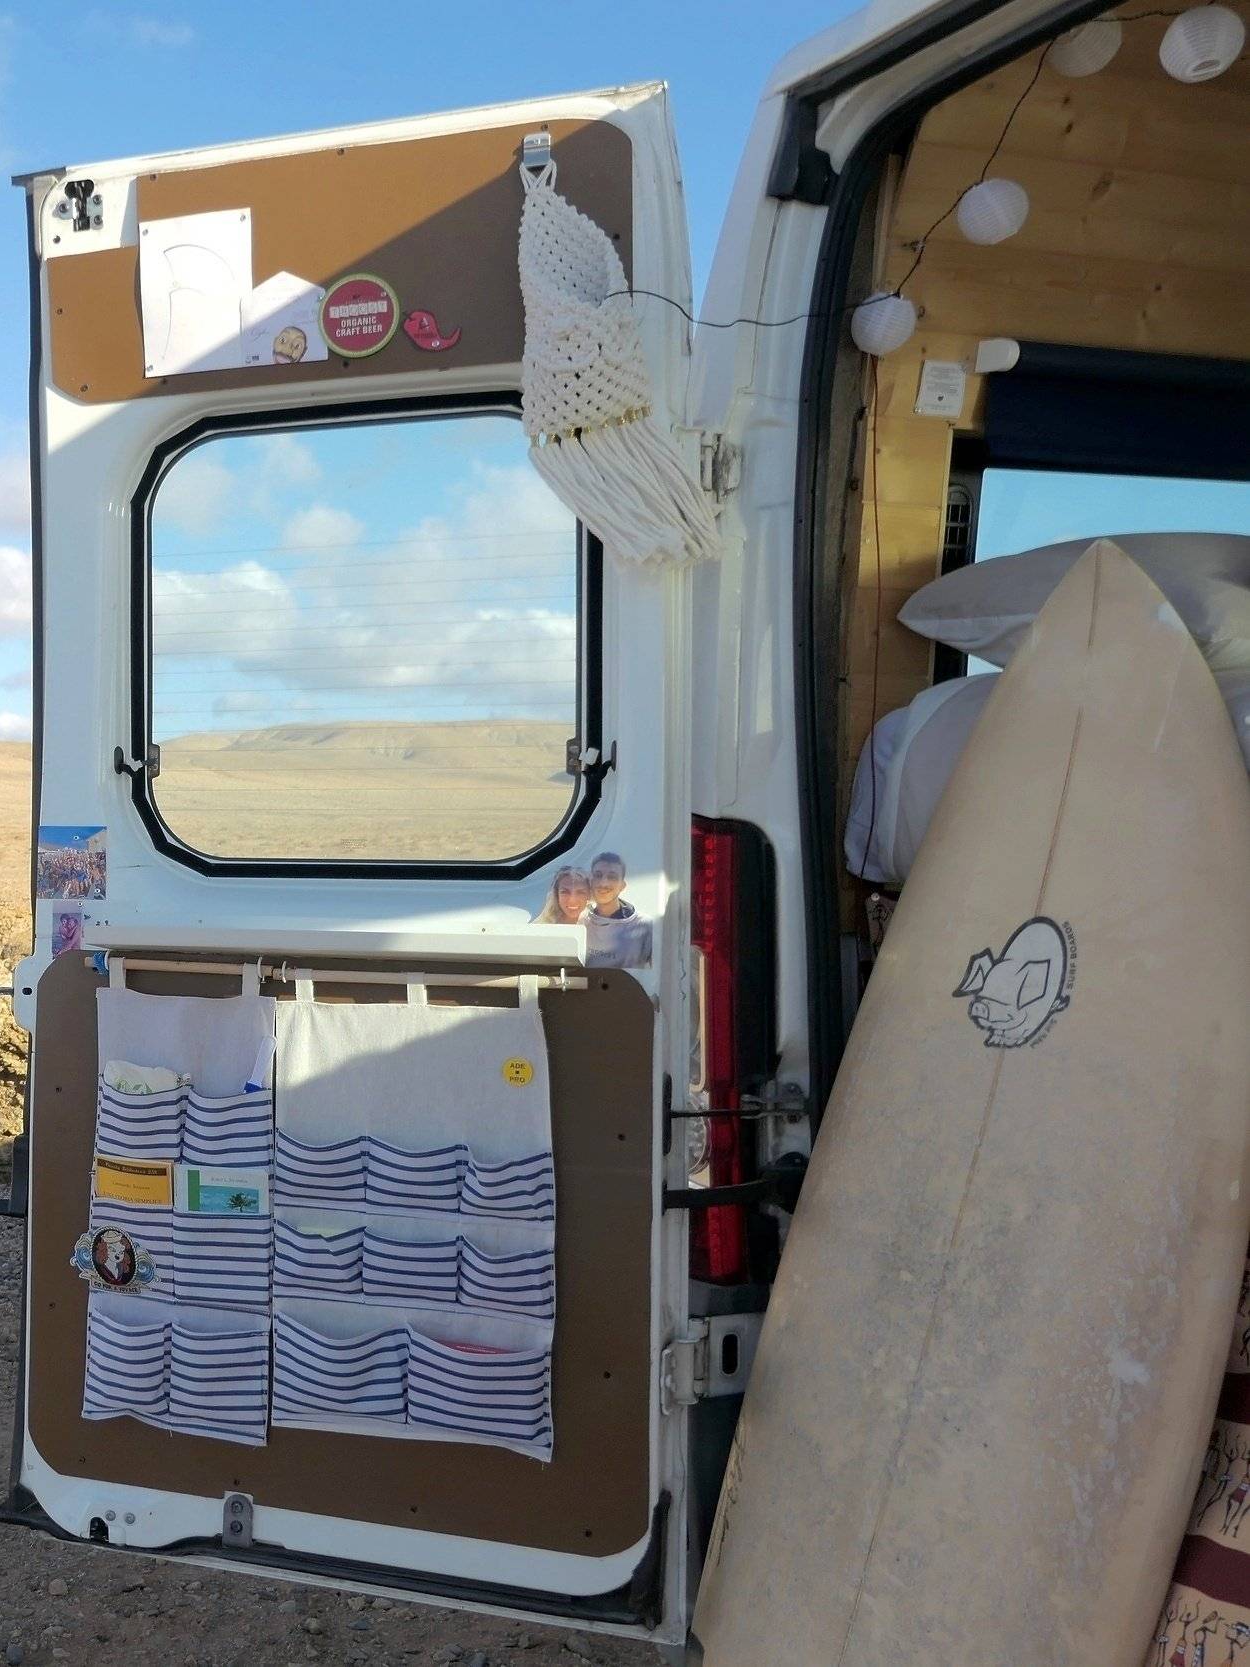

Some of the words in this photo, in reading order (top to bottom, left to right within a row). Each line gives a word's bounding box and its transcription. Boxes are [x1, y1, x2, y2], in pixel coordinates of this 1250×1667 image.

[335, 327, 360, 338] CRAFT
[362, 324, 383, 335] BEER
[340, 316, 377, 328] ORGANIC
[1062, 921, 1077, 960] BOARDS
[1066, 962, 1077, 990] SURF
